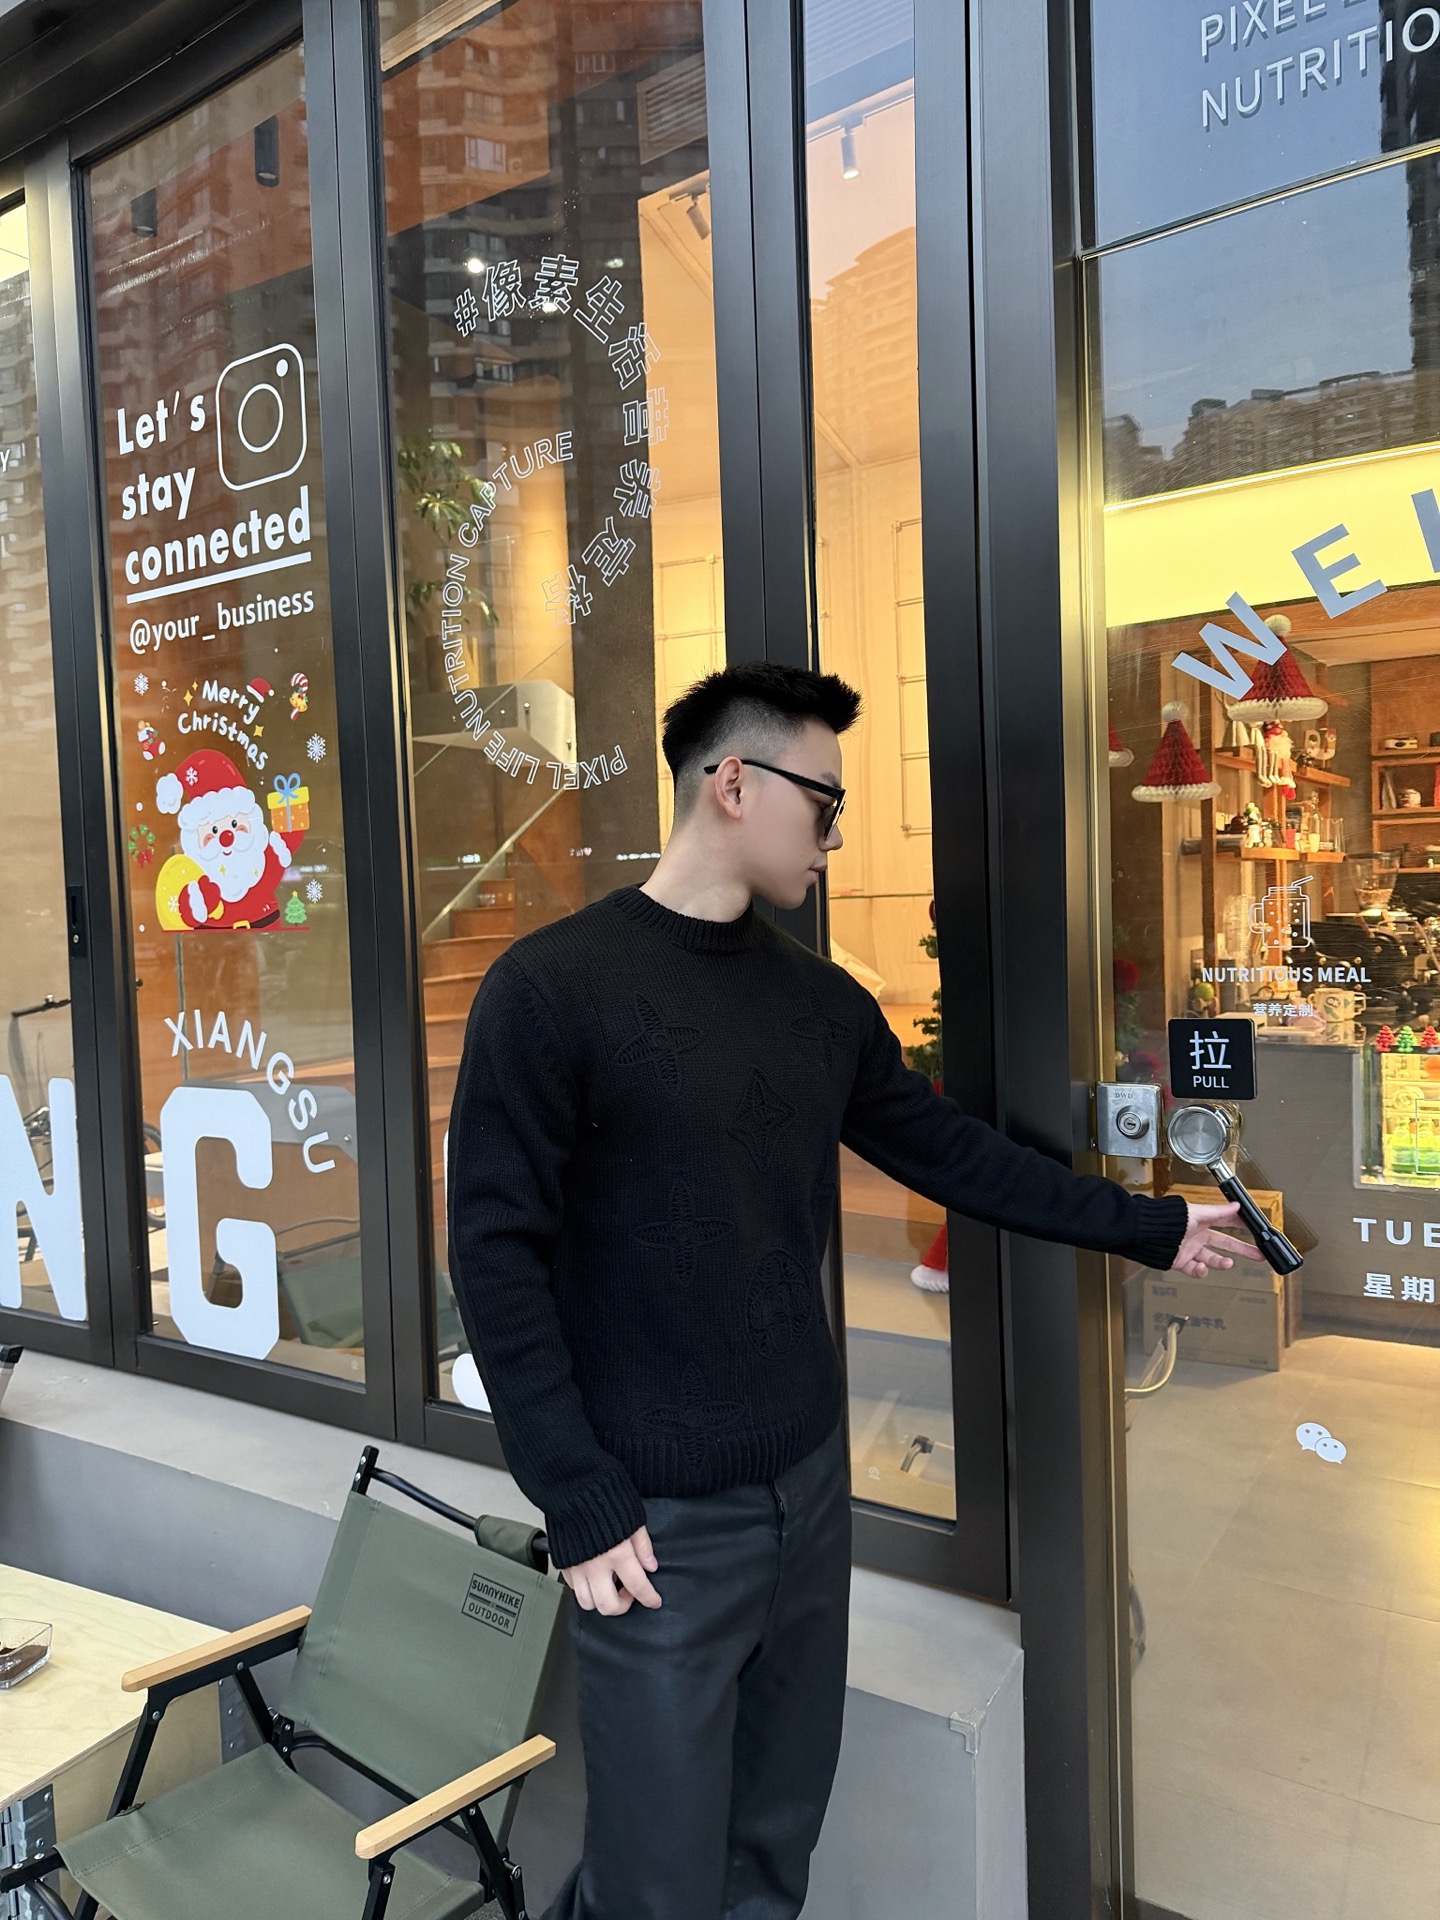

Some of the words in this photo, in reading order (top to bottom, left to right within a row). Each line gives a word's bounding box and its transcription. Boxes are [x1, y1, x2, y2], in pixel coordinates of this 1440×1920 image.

[1202, 7, 1440, 128] NUTRITIO
[117, 390, 206, 455] Let's
[121, 467, 196, 520] stay
[457, 430, 574, 548] CAPTURE
[125, 485, 311, 584] connected
[441, 553, 491, 741] NUTRITION
[202, 680, 260, 725] Merry
[177, 712, 268, 770] Christmas
[483, 730, 541, 785] LIFE
[546, 745, 628, 790] PIXEL
[1201, 966, 1313, 984] NUTRITIOUS
[1317, 966, 1372, 984] MEAL
[1189, 1030, 1232, 1070] 拉
[164, 1009, 336, 1173] XIANGSU
[1193, 1075, 1230, 1089] PULL
[1353, 1217, 1440, 1248] TUE
[1363, 1272, 1435, 1303] 星期
[468, 1602, 511, 1629] OUTDOOR
